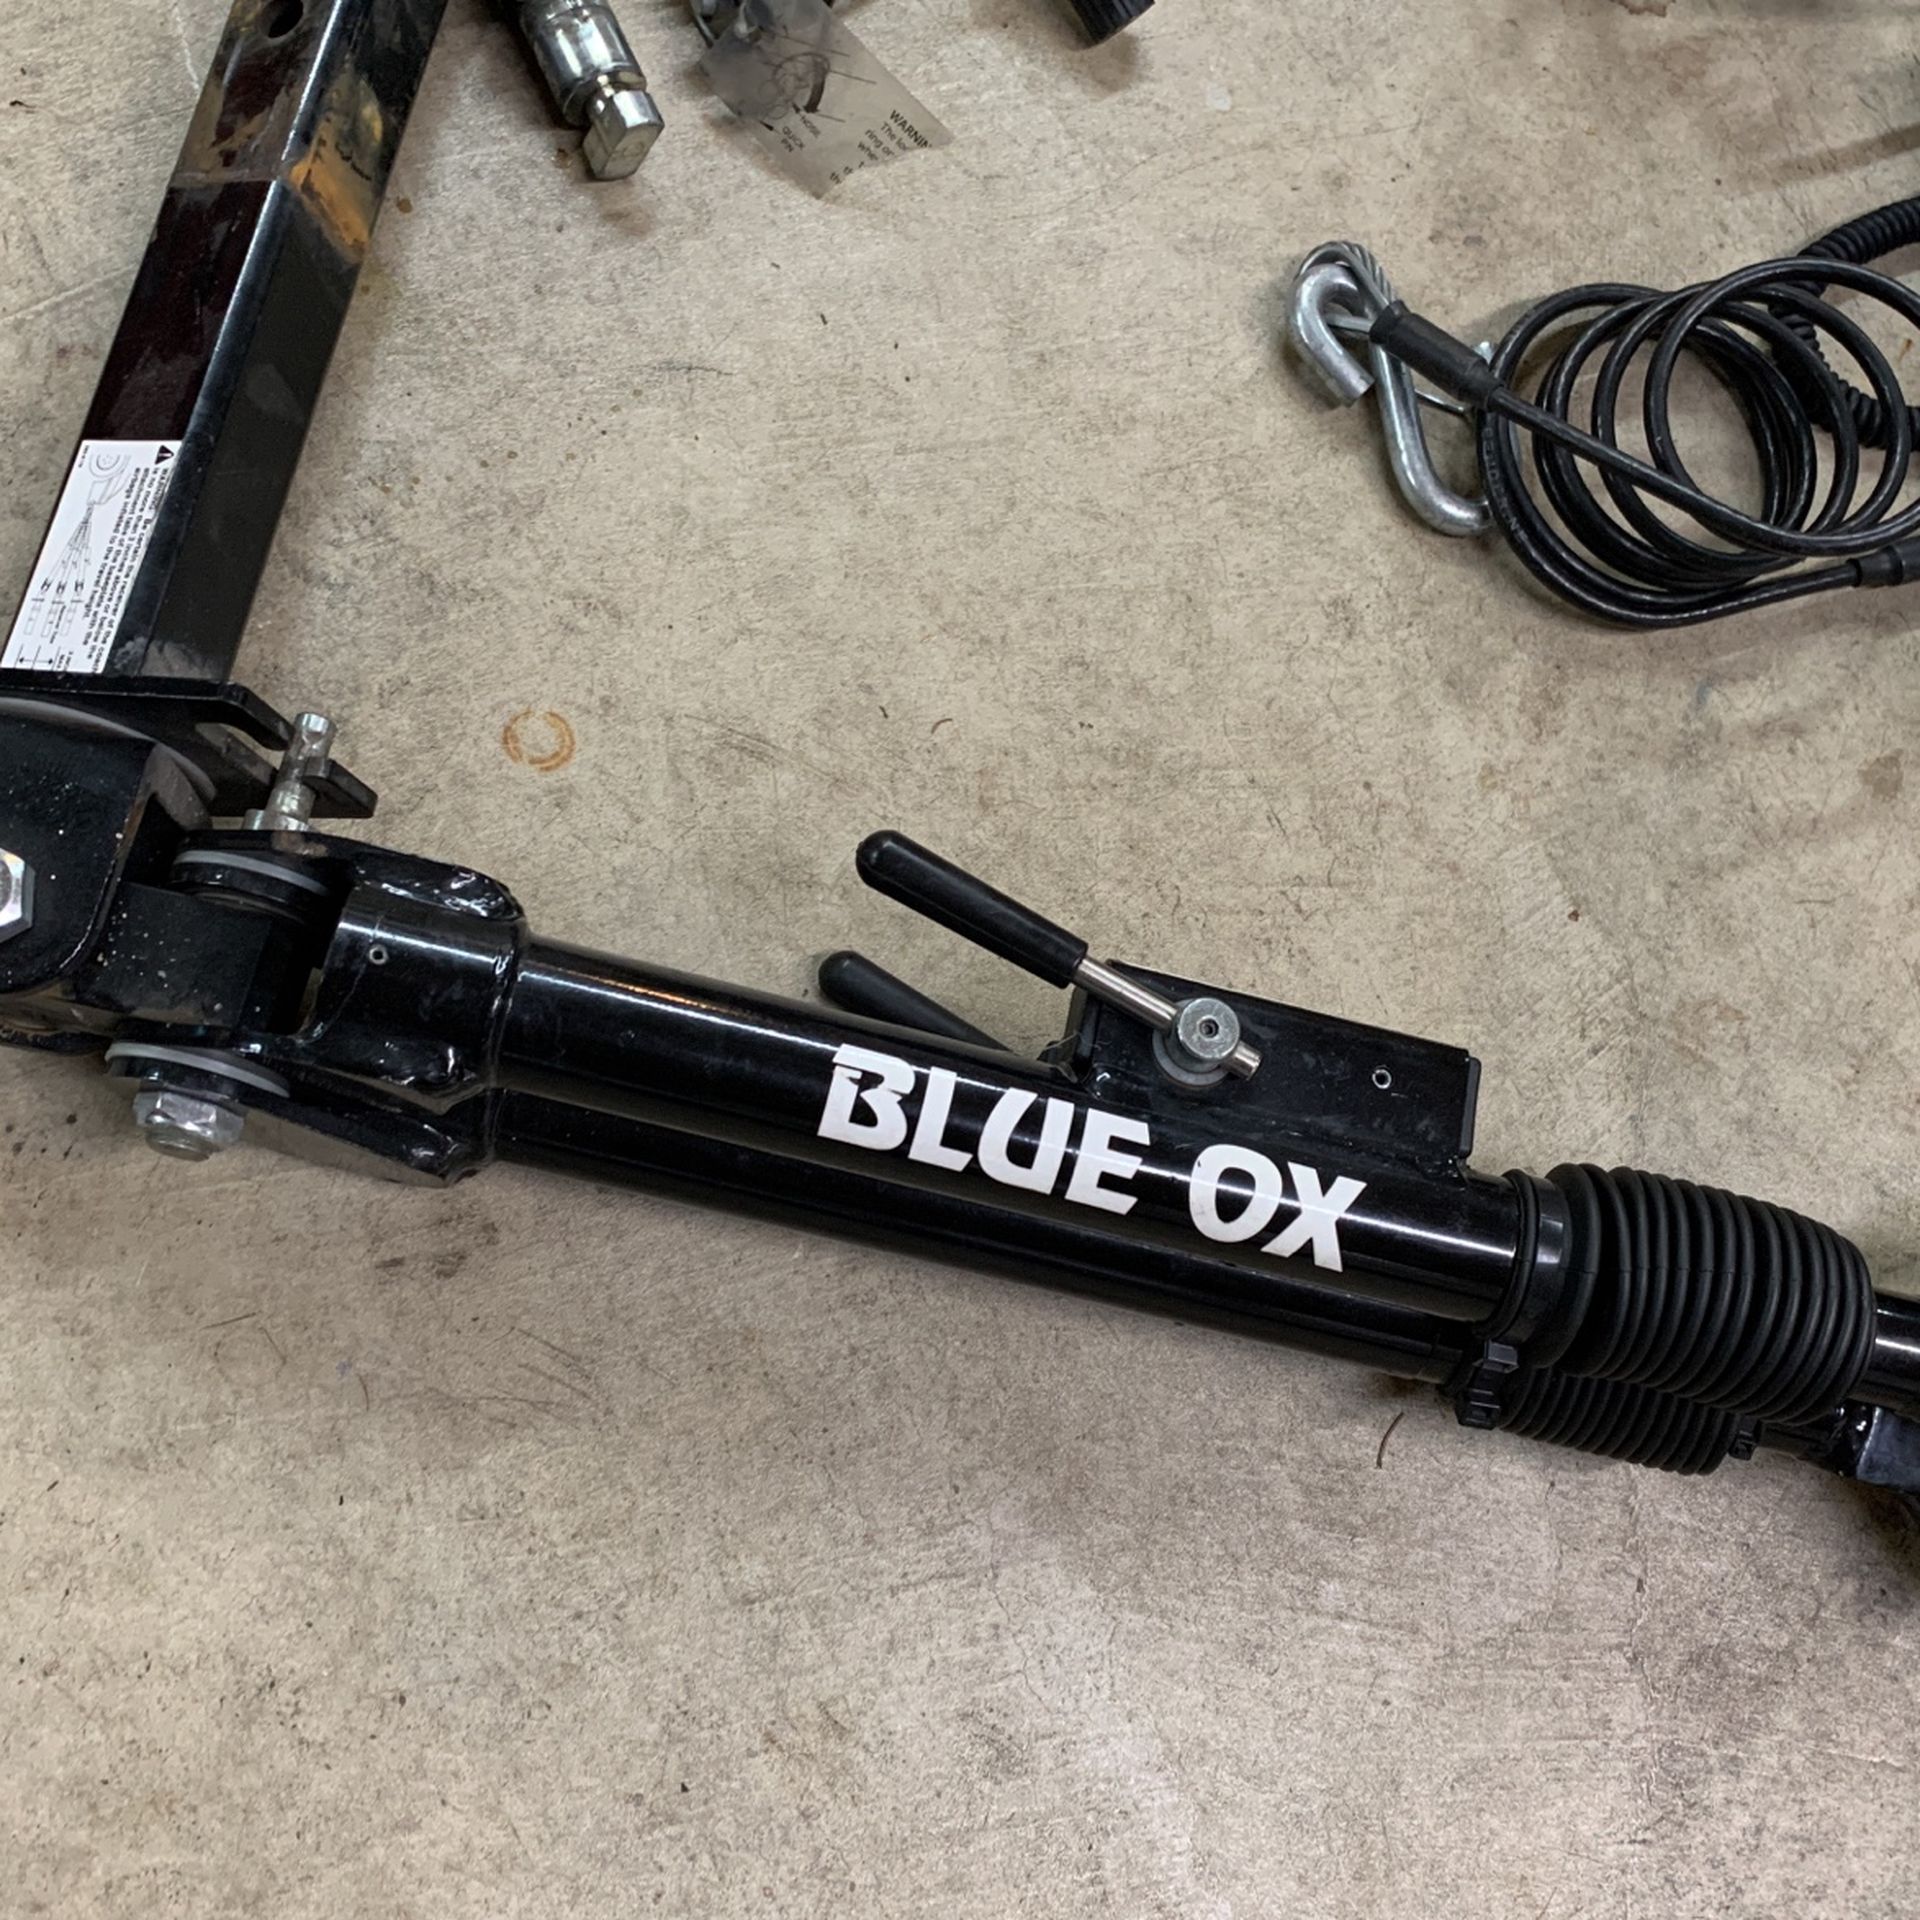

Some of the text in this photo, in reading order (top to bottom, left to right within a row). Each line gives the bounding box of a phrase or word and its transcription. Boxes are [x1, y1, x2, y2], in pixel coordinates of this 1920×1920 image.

[881, 121, 897, 141] The
[889, 109, 932, 148] WARNIN
[128, 467, 149, 514] attachment
[146, 477, 155, 487] no
[138, 490, 150, 511] more
[112, 501, 128, 533] inflated
[130, 515, 142, 533] than
[141, 518, 152, 529] Be
[109, 535, 117, 544] to
[117, 537, 125, 546] of
[130, 532, 145, 562] certain
[103, 546, 113, 559] the
[111, 549, 121, 562] the
[117, 543, 132, 572] inches
[94, 562, 107, 587] travel
[124, 564, 133, 578] the
[95, 565, 114, 607] baseplate
[107, 575, 121, 601] above
[111, 581, 128, 616] receiver
[103, 603, 111, 613] or
[89, 610, 99, 628] with
[107, 618, 115, 628] of
[83, 631, 92, 645] the
[93, 616, 106, 642] below
[101, 630, 111, 644] the
[87, 644, 97, 658] the
[817, 1043, 1367, 1273] BLUE OX
